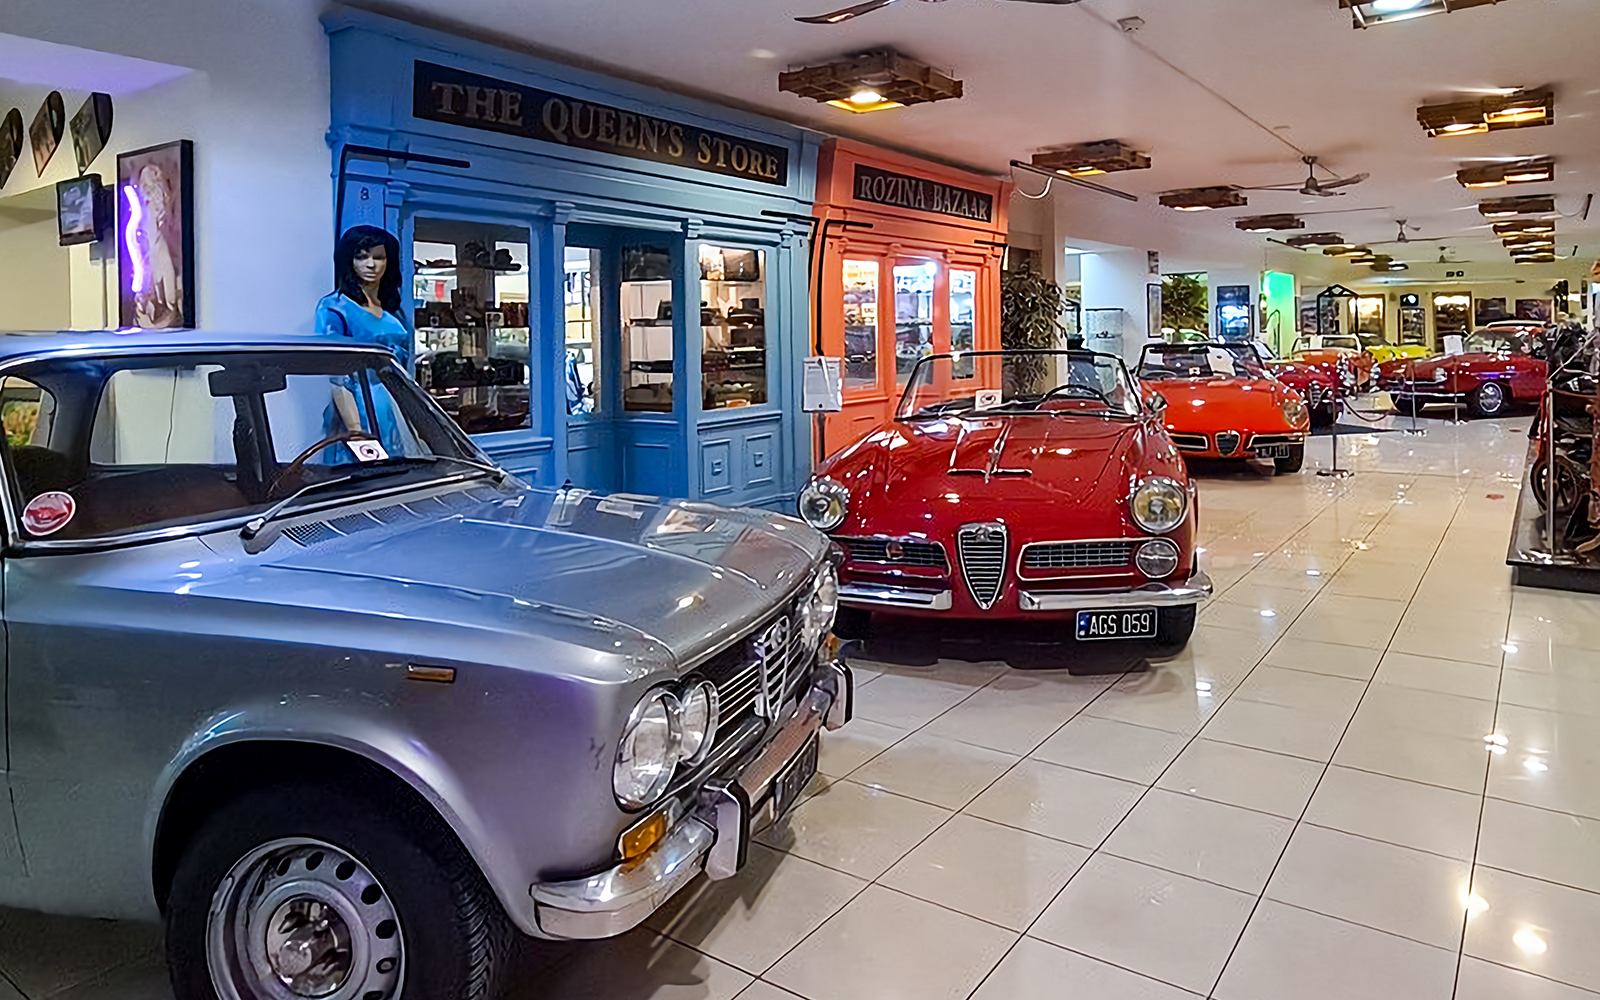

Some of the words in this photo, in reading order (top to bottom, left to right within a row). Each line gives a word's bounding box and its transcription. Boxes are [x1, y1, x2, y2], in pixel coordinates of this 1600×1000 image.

[432, 81, 523, 127] THE
[542, 98, 684, 158] QUEEN'S
[698, 133, 779, 179] STORE
[860, 175, 925, 209] ROZINA
[1089, 614, 1117, 635] AGS
[1122, 613, 1150, 634] 059
